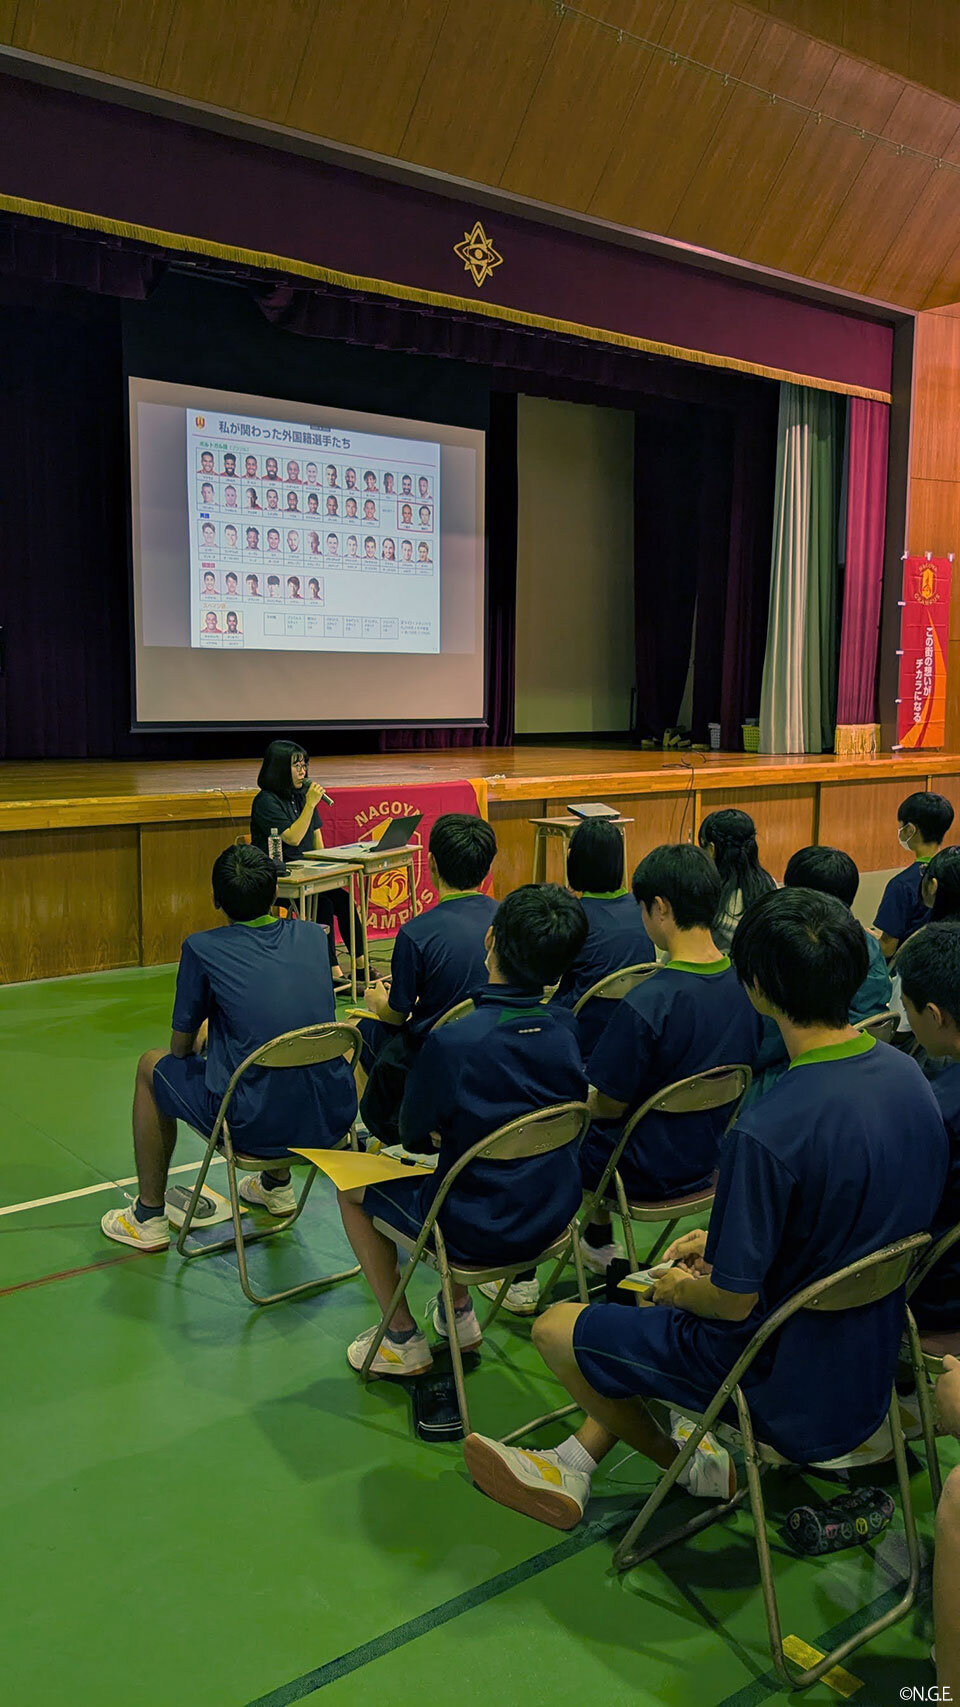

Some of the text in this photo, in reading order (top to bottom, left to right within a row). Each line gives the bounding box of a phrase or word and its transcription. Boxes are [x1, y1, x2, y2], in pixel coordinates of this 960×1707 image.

[218, 420, 351, 449] 私が関わった外国籍選手たち
[913, 659, 924, 723] チカラになる
[923, 627, 934, 697] この街の想いが
